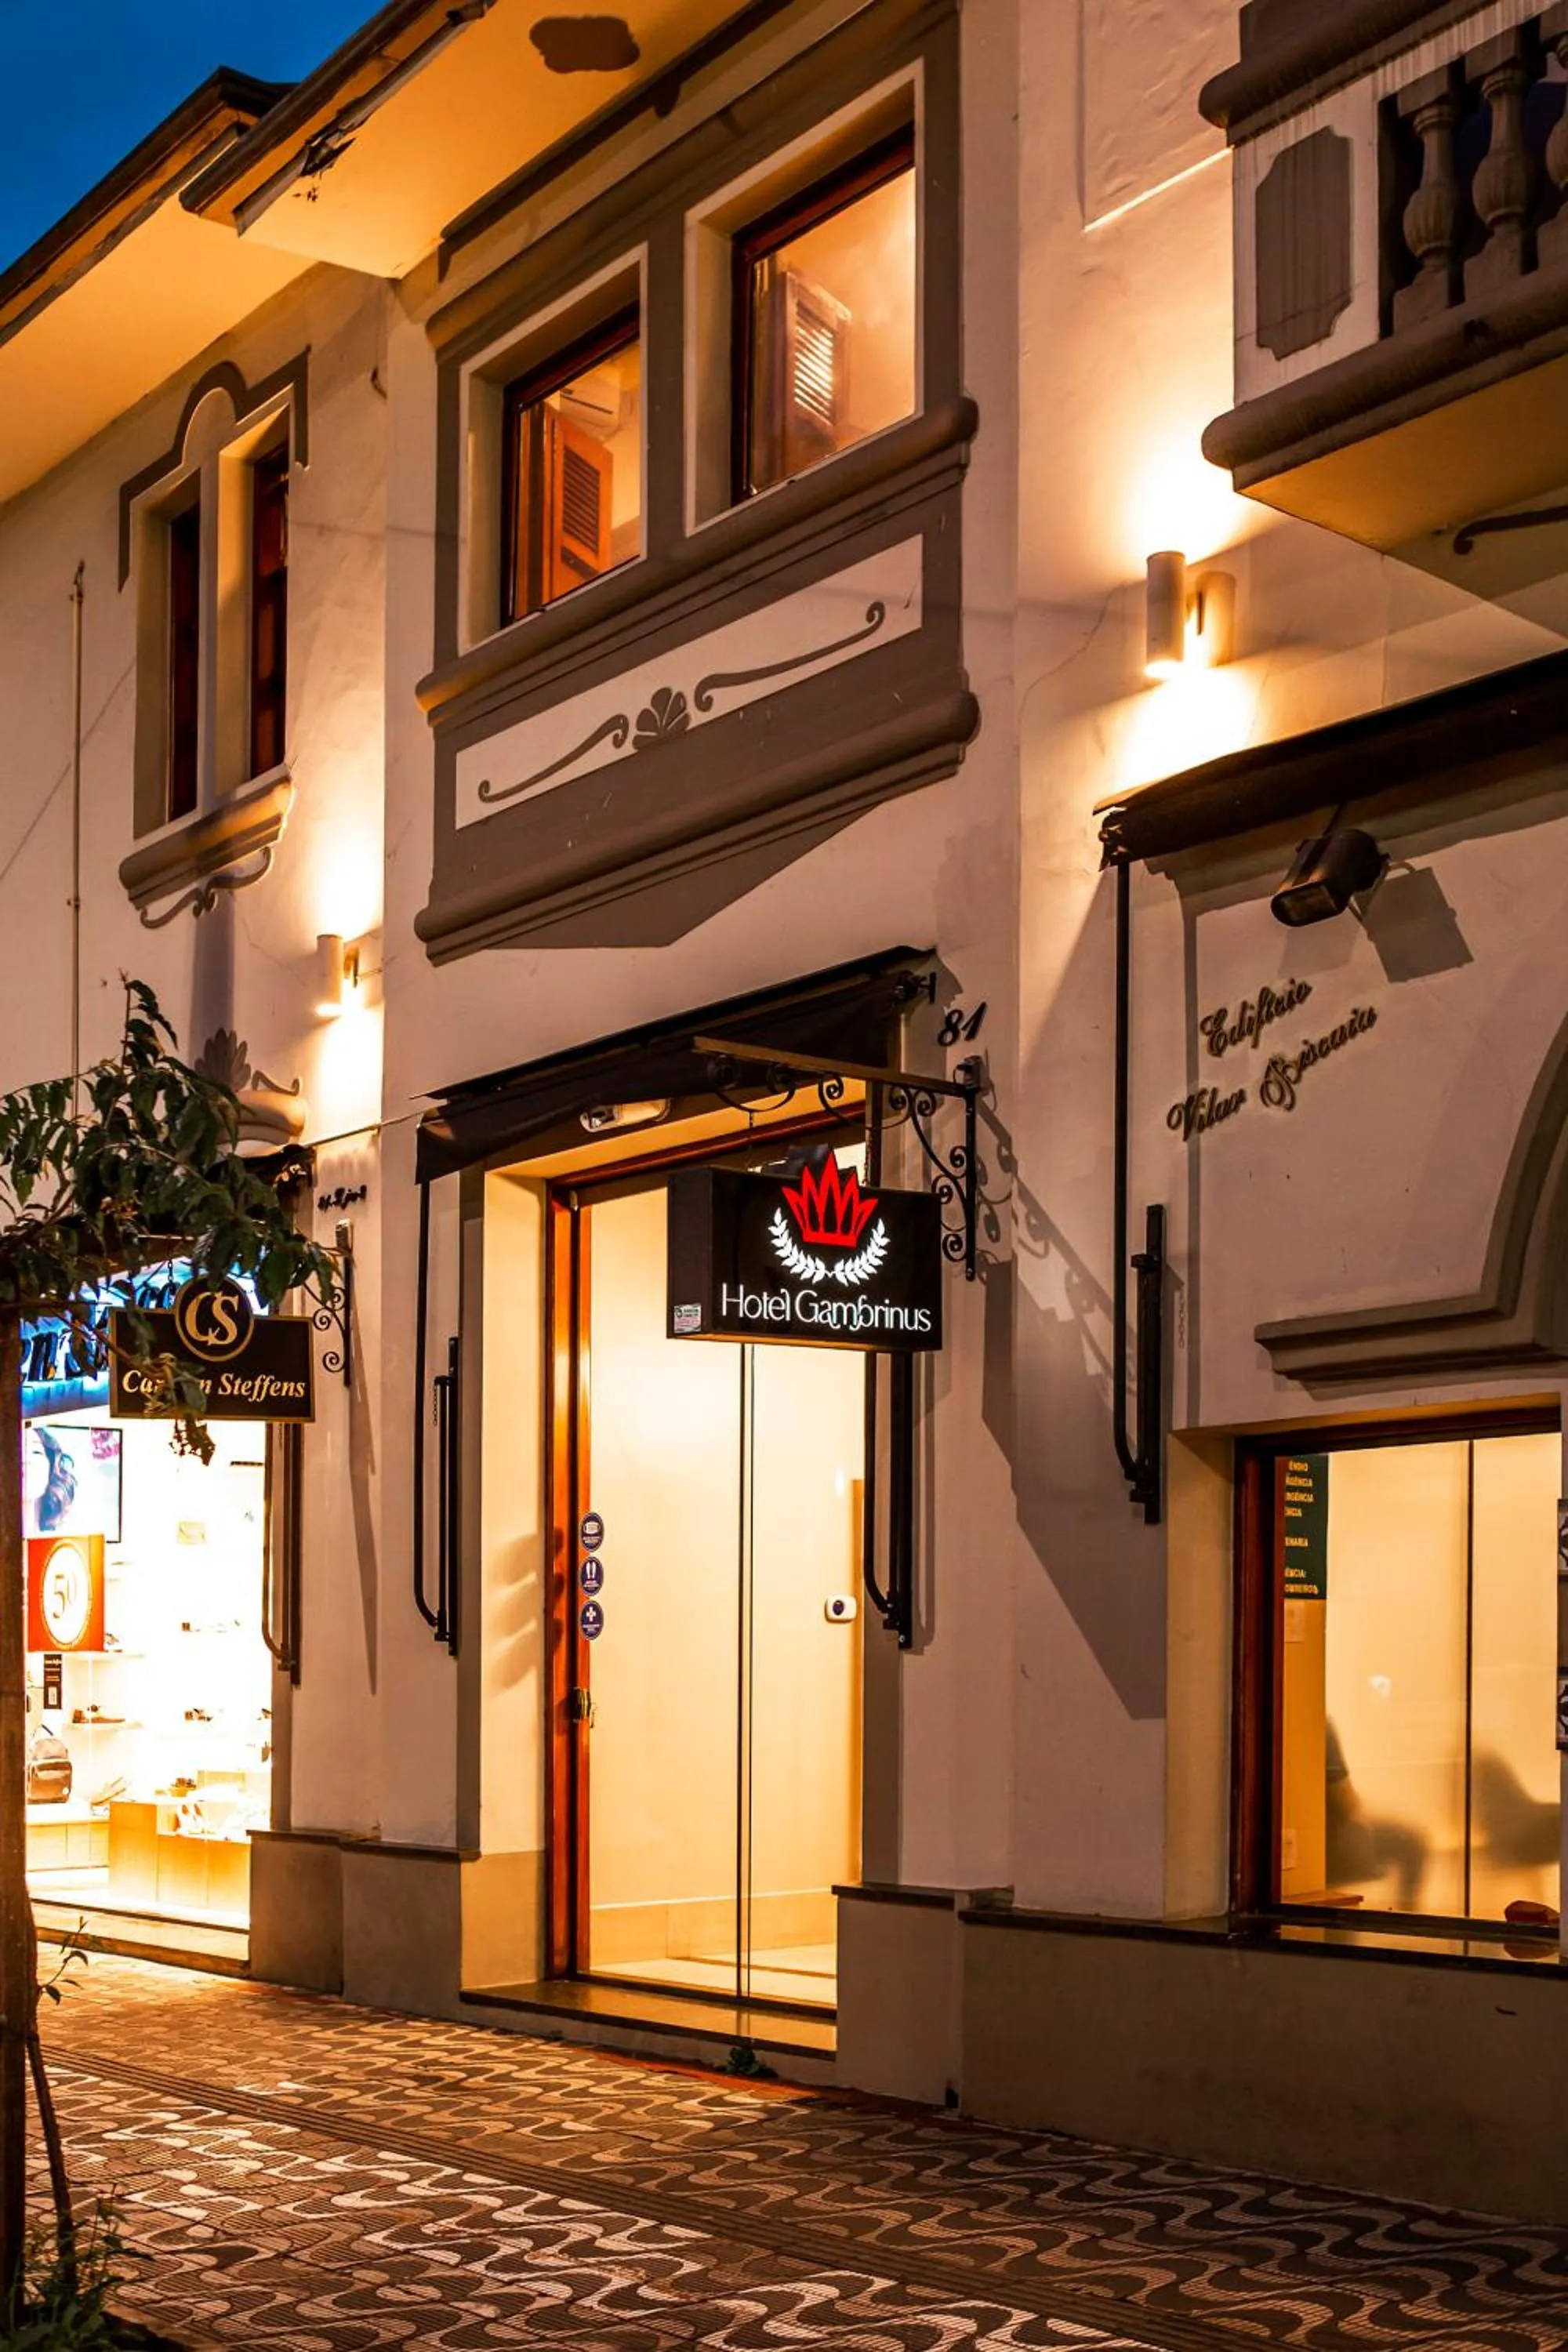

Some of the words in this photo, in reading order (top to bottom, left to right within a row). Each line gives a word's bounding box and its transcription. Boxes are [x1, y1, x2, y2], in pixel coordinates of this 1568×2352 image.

[938, 1001, 987, 1047] 81
[722, 1283, 791, 1322] Hotel
[795, 1290, 931, 1332] Gambrinus
[218, 1373, 306, 1403] Steffens
